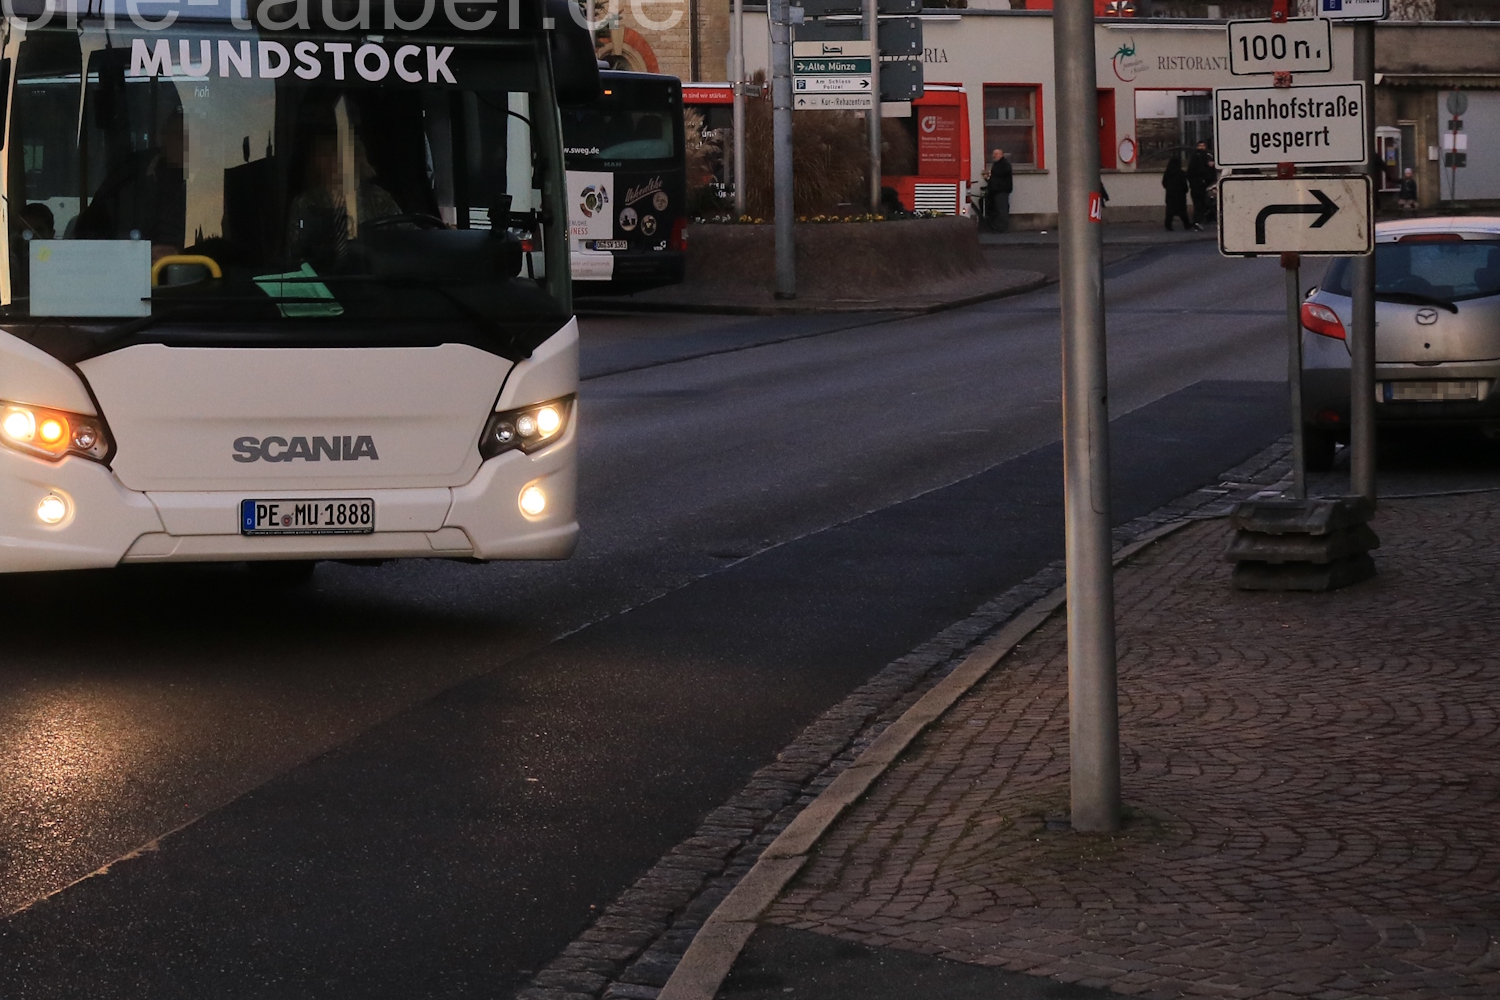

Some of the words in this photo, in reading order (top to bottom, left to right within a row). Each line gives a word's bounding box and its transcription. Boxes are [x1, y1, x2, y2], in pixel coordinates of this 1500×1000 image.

[130, 38, 457, 84] MUNDSTOCK
[1239, 34, 1287, 62] 100
[808, 62, 825, 71] Alte
[828, 62, 856, 71] Münze
[1158, 56, 1228, 70] RISTORANT
[1221, 95, 1359, 122] Bahnhofstraße
[563, 147, 600, 156] w.sweg.de
[1250, 126, 1330, 153] gesperrt
[232, 435, 380, 463] SCANIA
[256, 504, 280, 526] PE
[295, 504, 319, 526] MU
[324, 503, 370, 525] 1888
